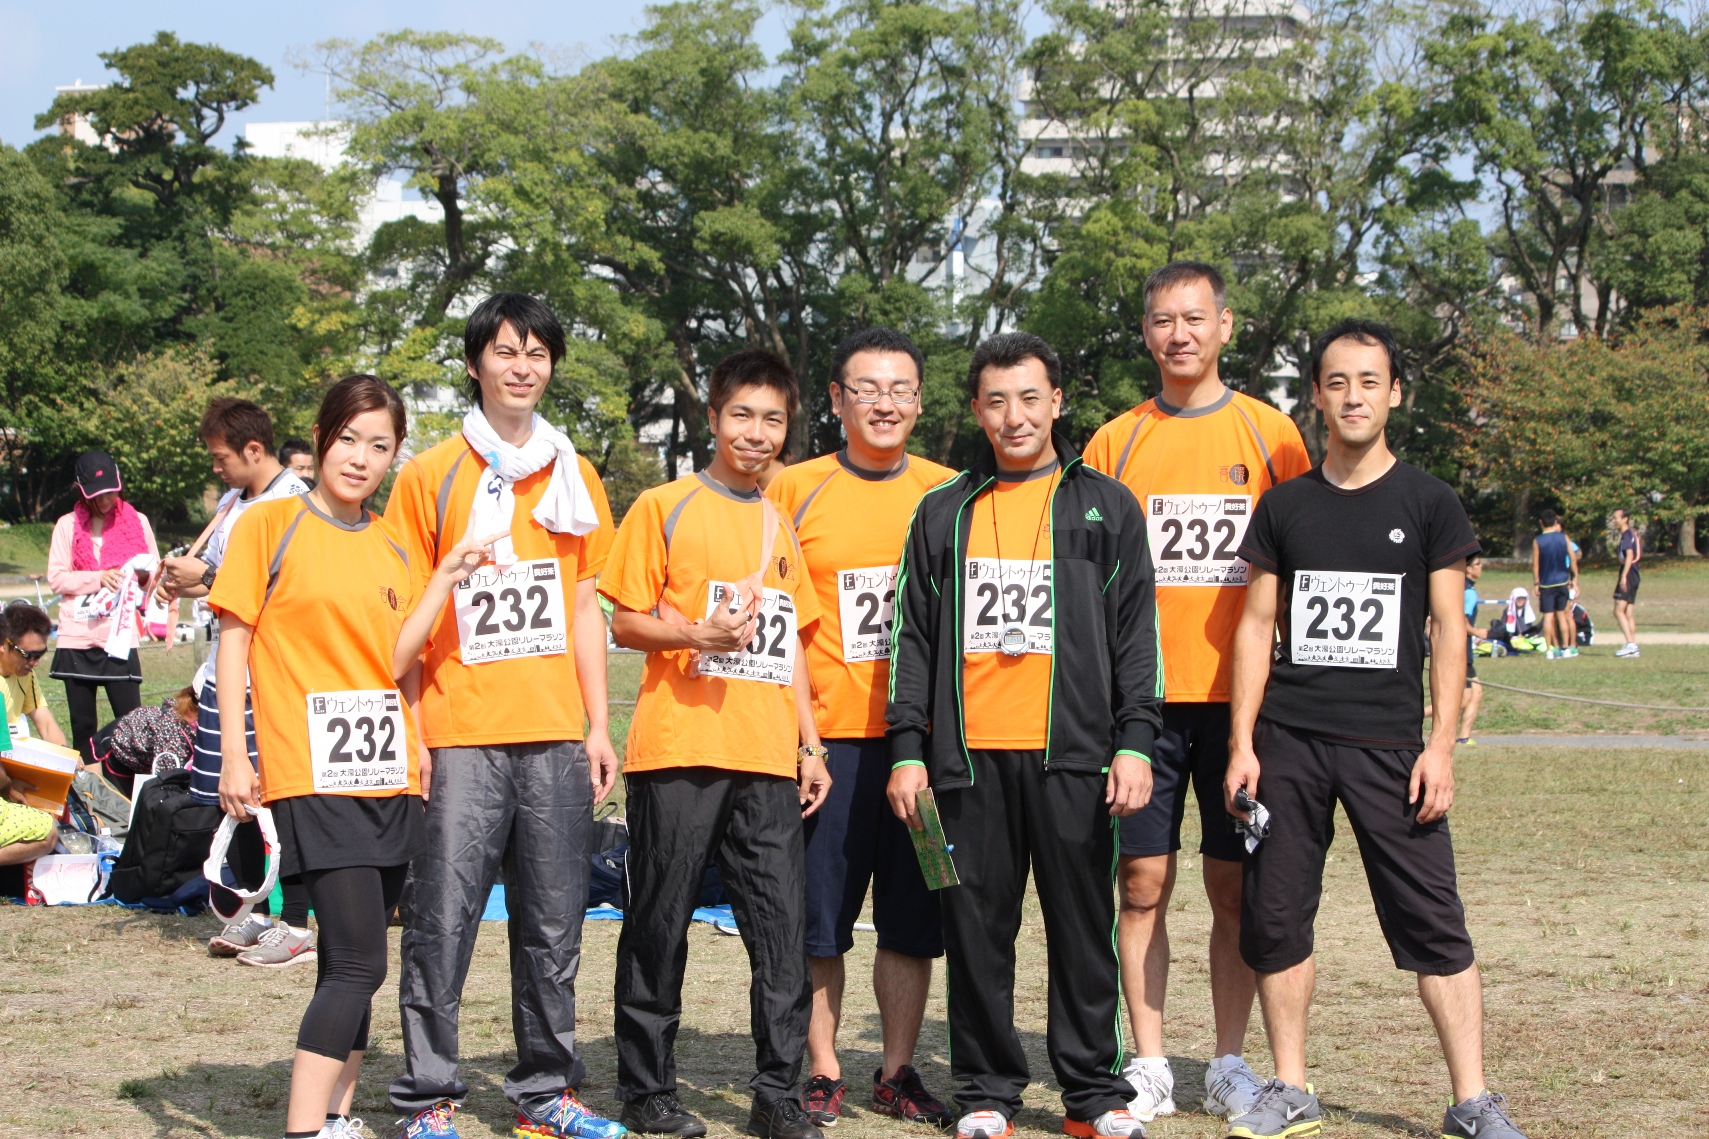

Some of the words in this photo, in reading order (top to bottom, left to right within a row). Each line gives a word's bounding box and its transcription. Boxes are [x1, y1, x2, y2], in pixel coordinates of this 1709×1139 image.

[1160, 518, 1236, 561] 232
[471, 584, 553, 636] 232
[976, 582, 1052, 628] 232
[1305, 595, 1384, 642] 232
[327, 715, 397, 764] 232
